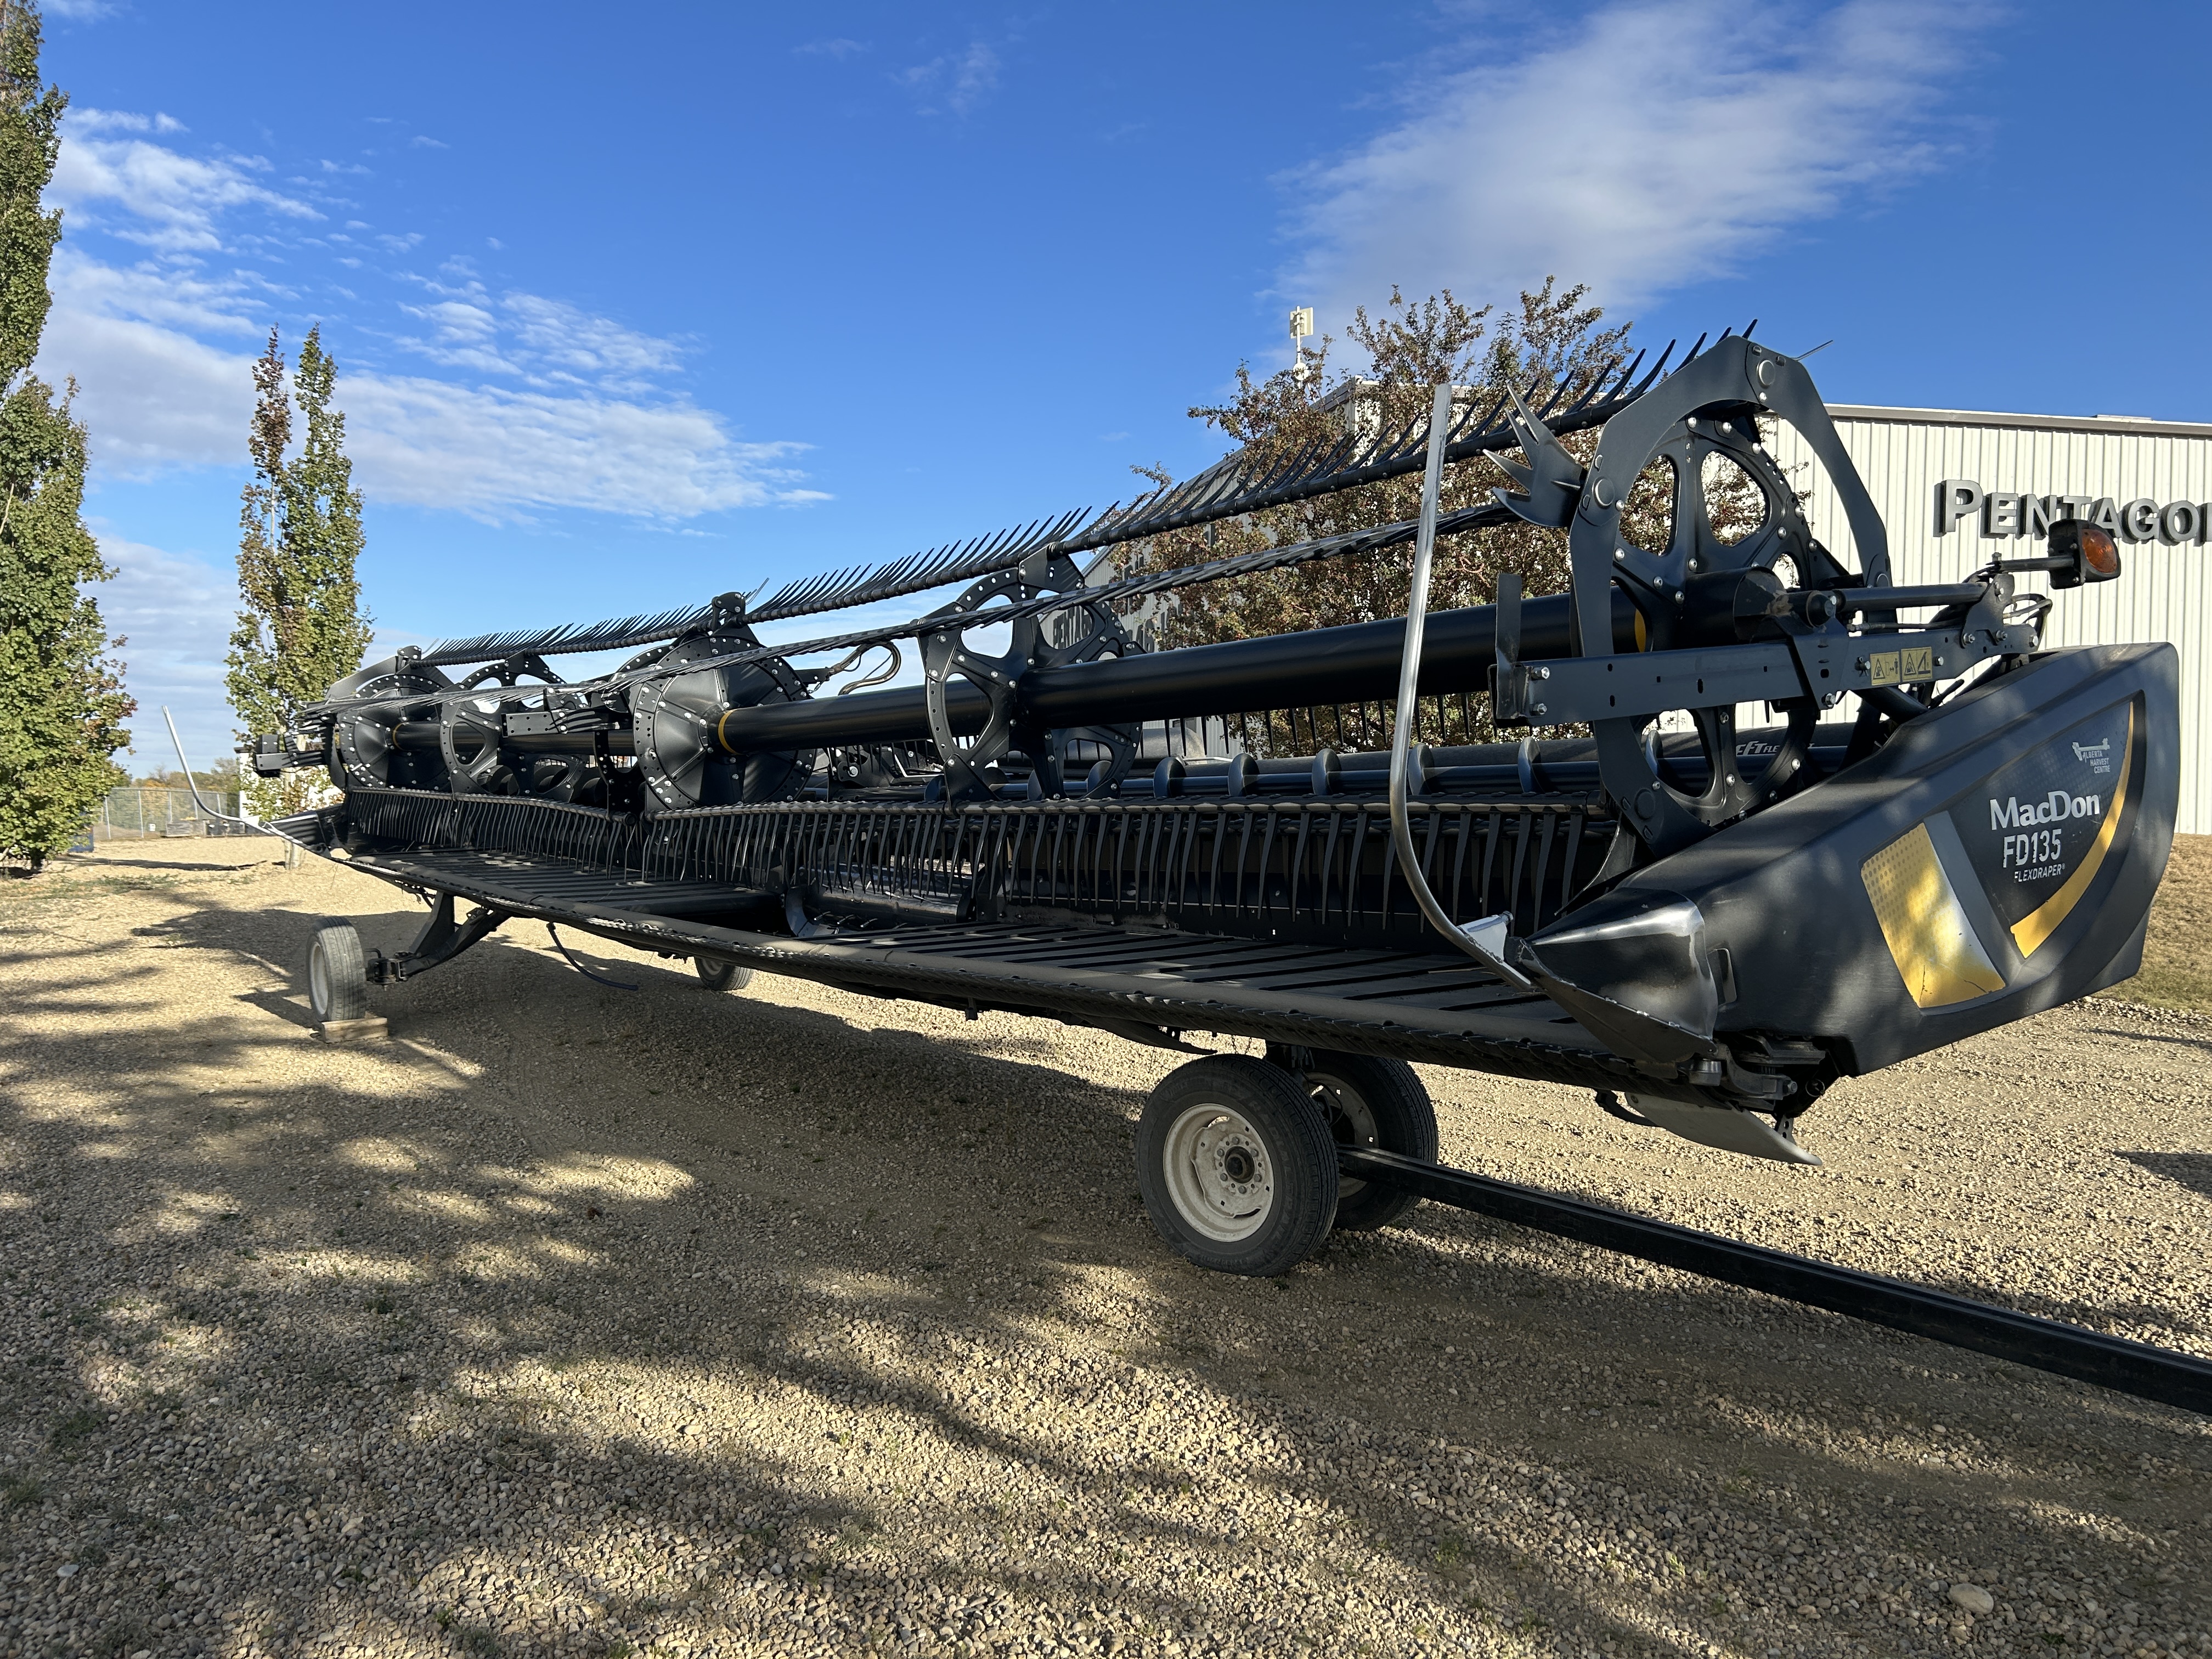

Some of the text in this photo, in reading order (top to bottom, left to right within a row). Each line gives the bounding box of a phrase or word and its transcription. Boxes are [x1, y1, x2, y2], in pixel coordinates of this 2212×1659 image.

[1941, 479, 2212, 543] PENTAGO
[2083, 750, 2103, 763] ALBERTA
[2090, 758, 2109, 766] HARVEST
[1989, 791, 2101, 831] MacDon
[2002, 828, 2062, 868] FD135
